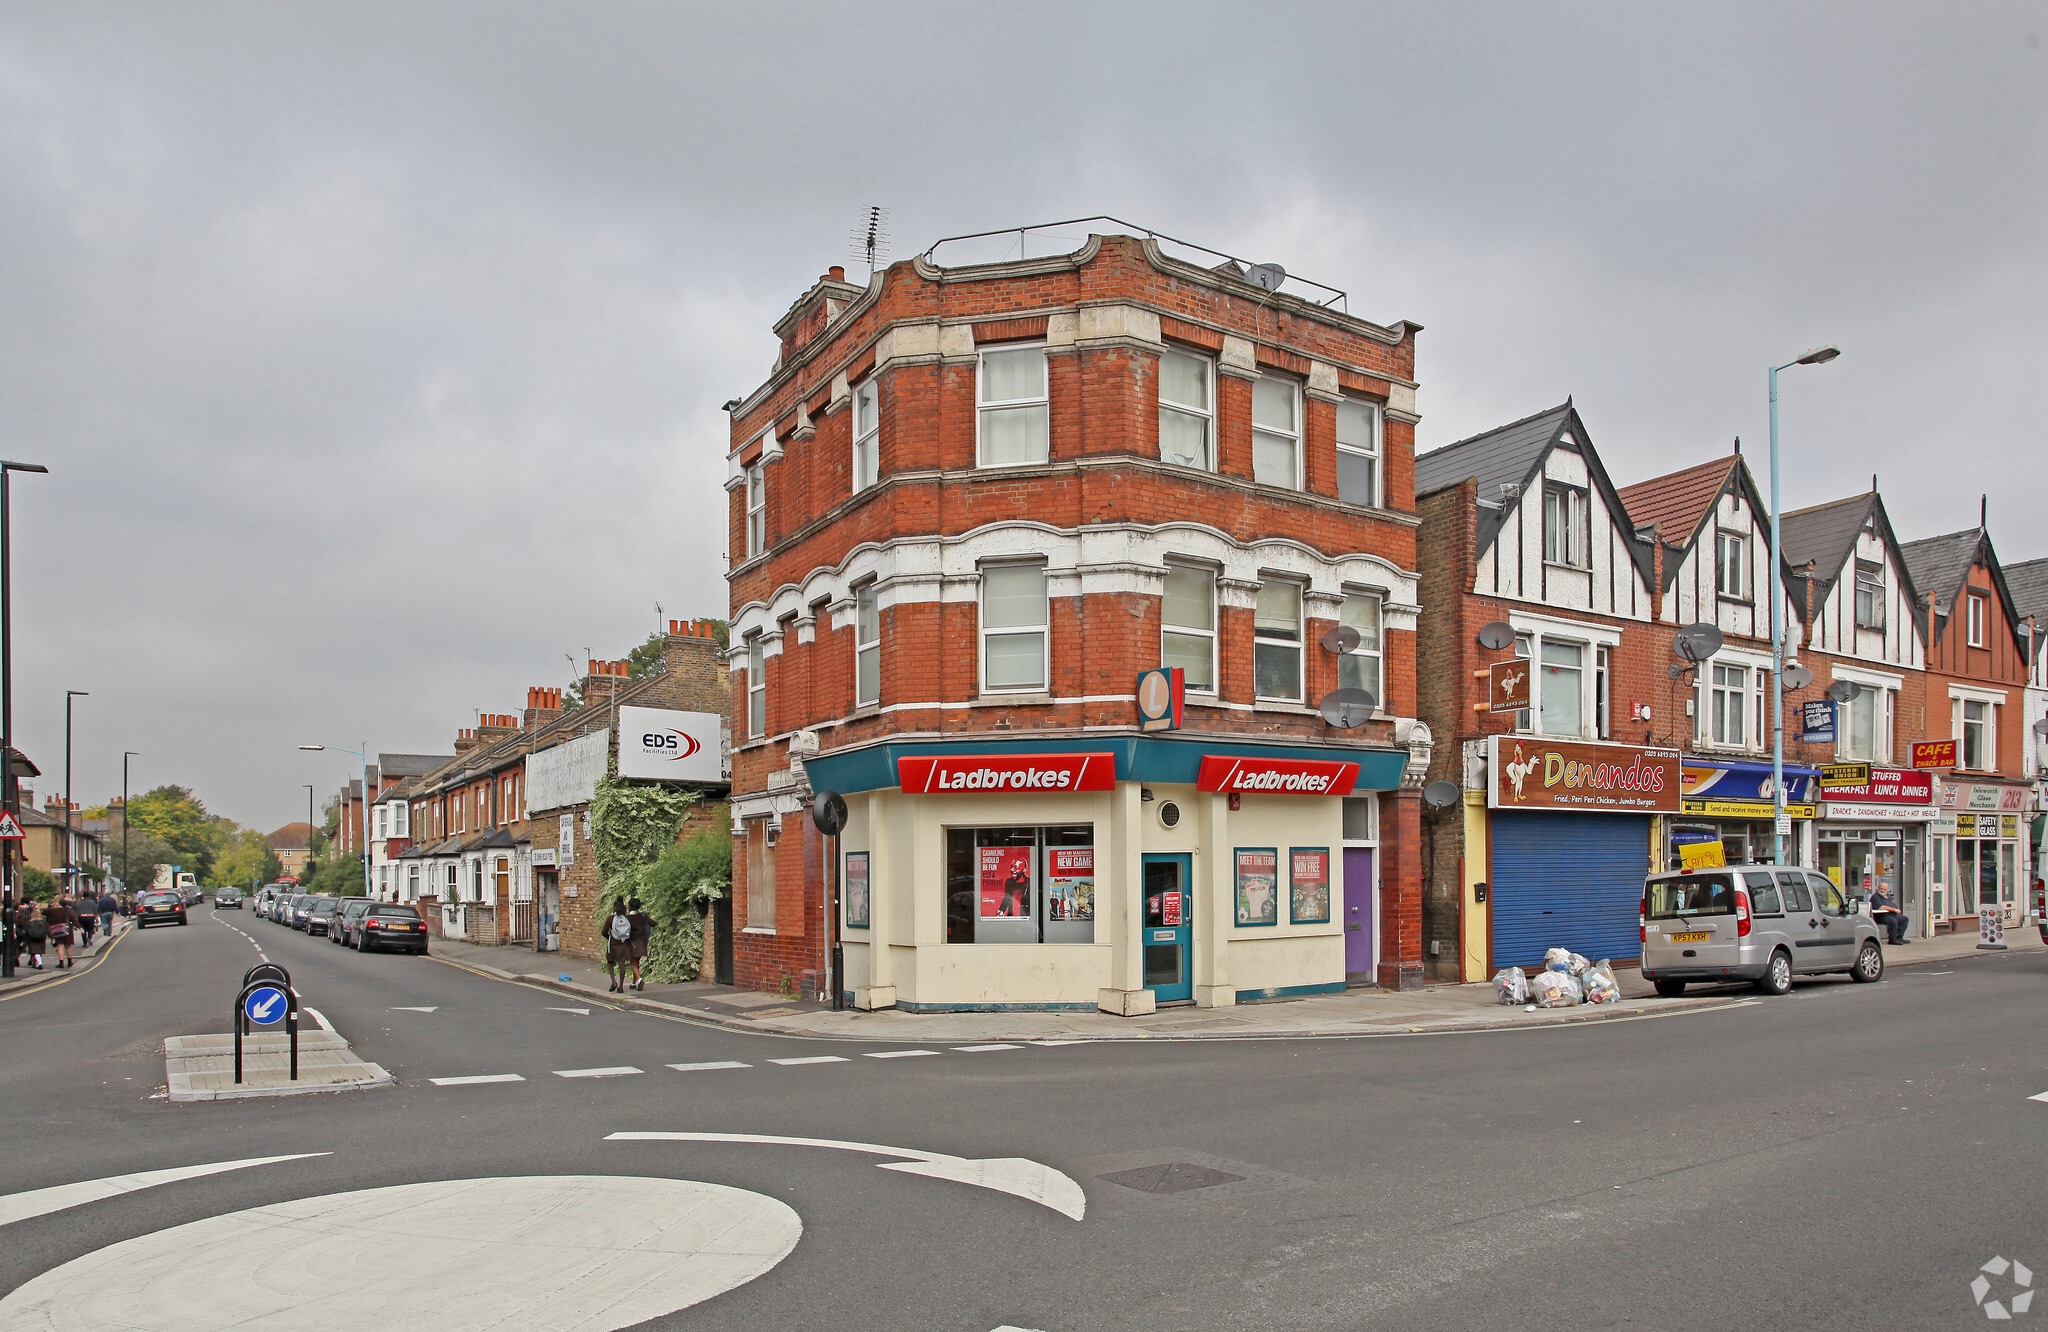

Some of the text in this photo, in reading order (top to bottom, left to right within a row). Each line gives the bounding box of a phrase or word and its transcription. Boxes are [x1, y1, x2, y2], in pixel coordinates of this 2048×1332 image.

[642, 733, 678, 749] EDS
[1803, 733, 1833, 741] NEWSAGENTS
[1916, 744, 1953, 756] CAFE
[1543, 752, 1664, 793] Denandos
[1872, 771, 1902, 782] STUFFED
[938, 768, 1071, 789] Ladbrokes
[1232, 770, 1330, 791] Ladbrokes
[1874, 784, 1898, 796] LUNCH
[1902, 785, 1928, 797] DINNER
[1554, 795, 1570, 803] Fried,
[1596, 796, 1618, 805] Chicken,
[1619, 797, 1635, 805] Jumbo
[1636, 798, 1656, 808] Burgers
[2003, 790, 2022, 808] 213
[1858, 808, 1887, 816] SANDWICHES
[1956, 815, 1974, 824] PICTURE
[1980, 816, 1997, 826] SAFETY
[1980, 826, 1996, 836] GLASS
[1058, 856, 1092, 867] NEW GAME
[1240, 856, 1276, 866] MEET THE TEAM
[1294, 862, 1320, 872] WIN FREE
